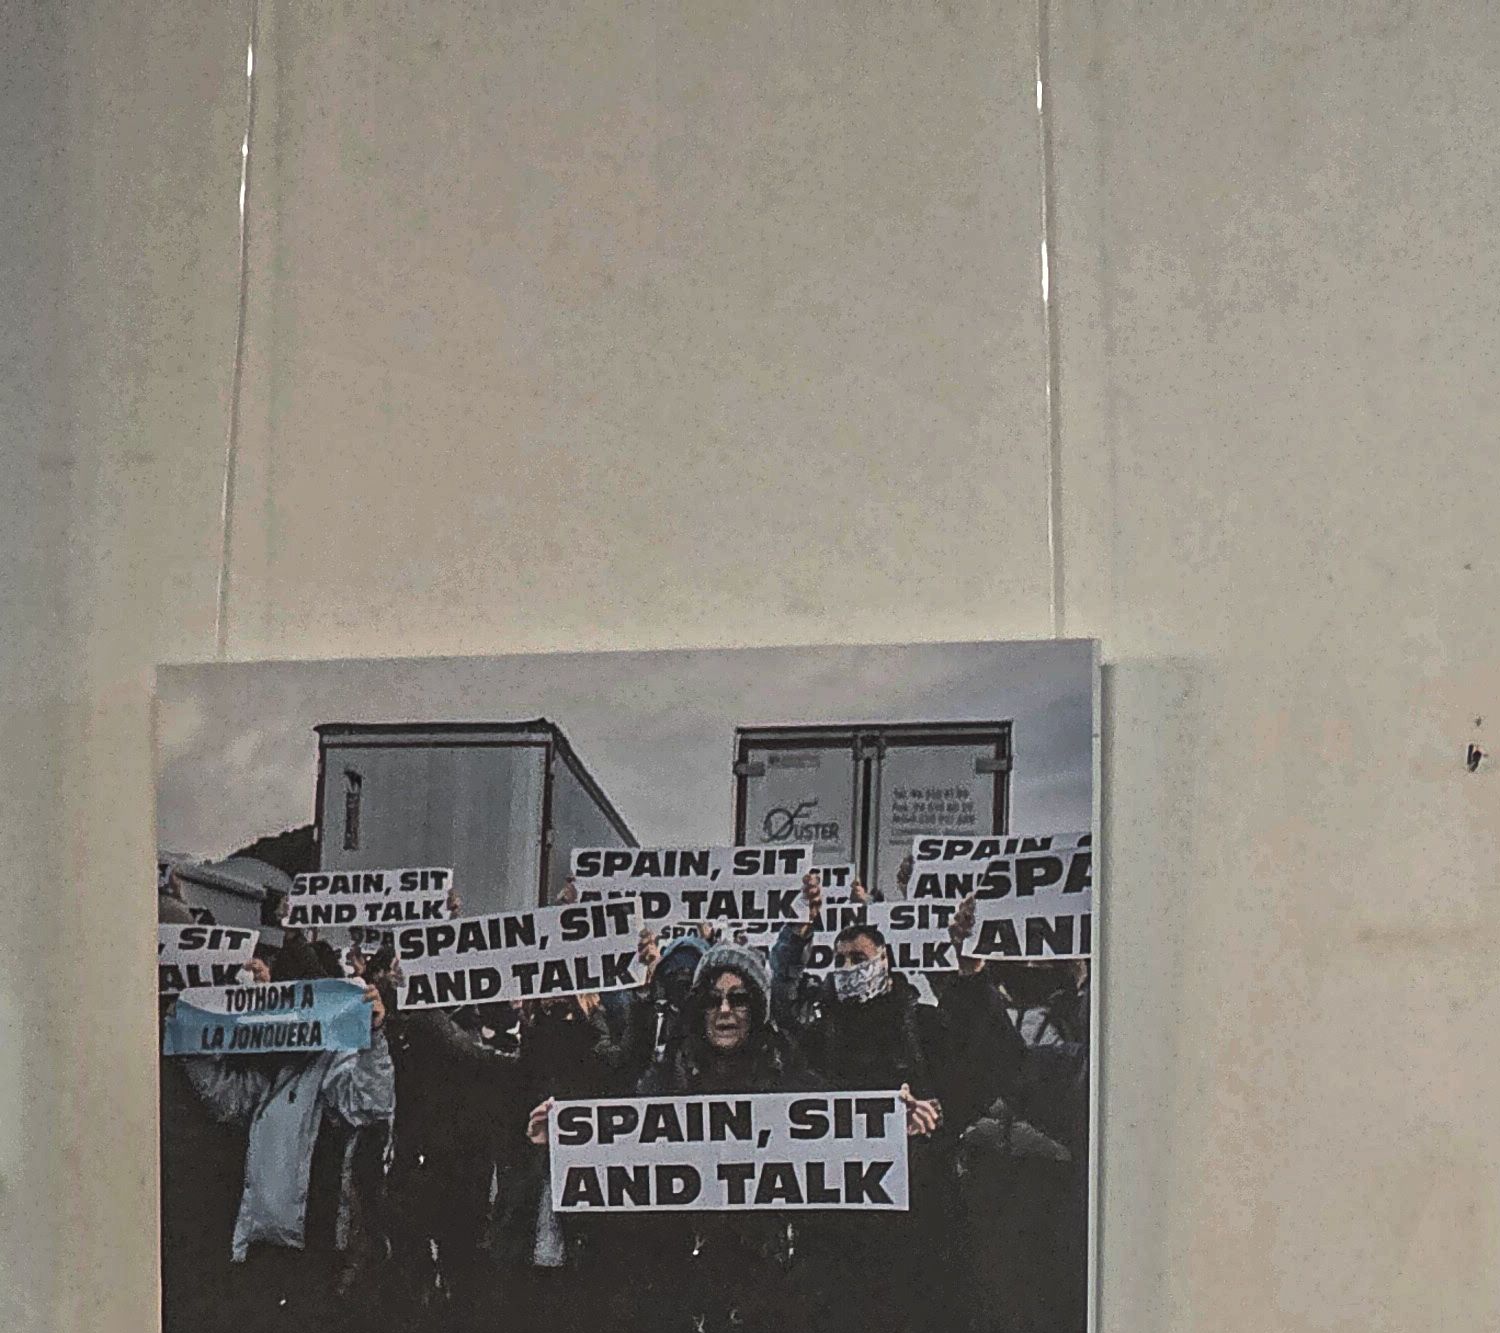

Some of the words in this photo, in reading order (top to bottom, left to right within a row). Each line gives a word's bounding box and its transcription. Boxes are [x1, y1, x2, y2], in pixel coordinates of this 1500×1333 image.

[576, 850, 721, 882] SPAIN,
[733, 848, 806, 876] SIT
[290, 873, 392, 896] SPAIN,
[400, 870, 448, 892] SIT
[914, 873, 984, 899] AN
[288, 903, 357, 924] AND
[364, 900, 445, 922] TALK
[681, 890, 801, 920] TALK
[890, 904, 956, 931] SIT
[178, 928, 251, 950] SIT
[399, 913, 549, 960] SPAIN,
[560, 901, 635, 942] SIT
[972, 914, 1092, 957] AN
[159, 963, 243, 993] ALK
[405, 966, 501, 1006] AND
[511, 951, 638, 996] TALK
[225, 985, 297, 1012] TOTHOM
[301, 984, 314, 1008] A
[201, 1027, 225, 1050] LA
[229, 1021, 322, 1050] JONQUERA
[557, 1100, 771, 1149] SPAIN,
[788, 1097, 896, 1140] SIT
[560, 1164, 702, 1207] AND
[716, 1161, 895, 1205] TALK
